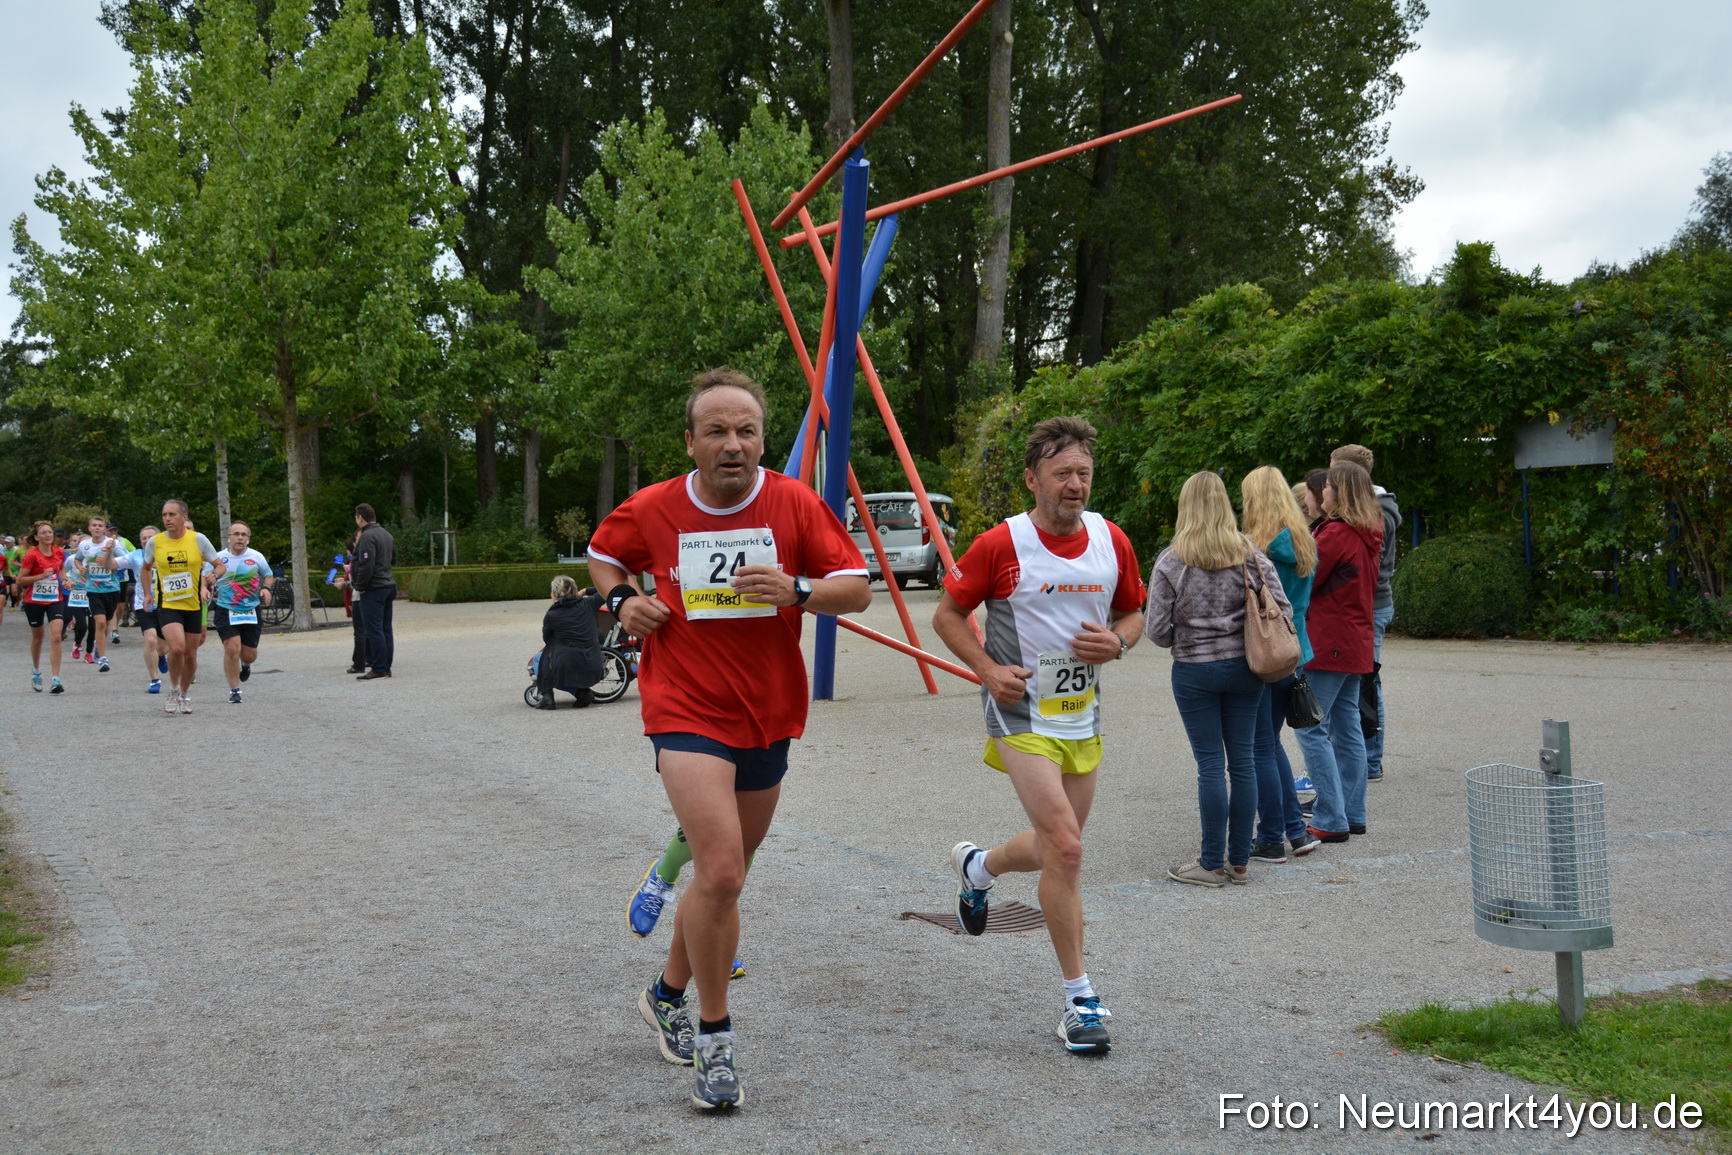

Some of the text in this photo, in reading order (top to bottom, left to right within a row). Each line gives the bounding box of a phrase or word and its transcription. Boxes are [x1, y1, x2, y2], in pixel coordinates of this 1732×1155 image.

[681, 538, 760, 550] PARTL Neumarkt
[36, 584, 57, 593] 2547
[169, 578, 188, 591] 293
[1057, 584, 1105, 593] KLEBL
[687, 593, 716, 605] CHARLY
[1039, 657, 1067, 667] PARTL
